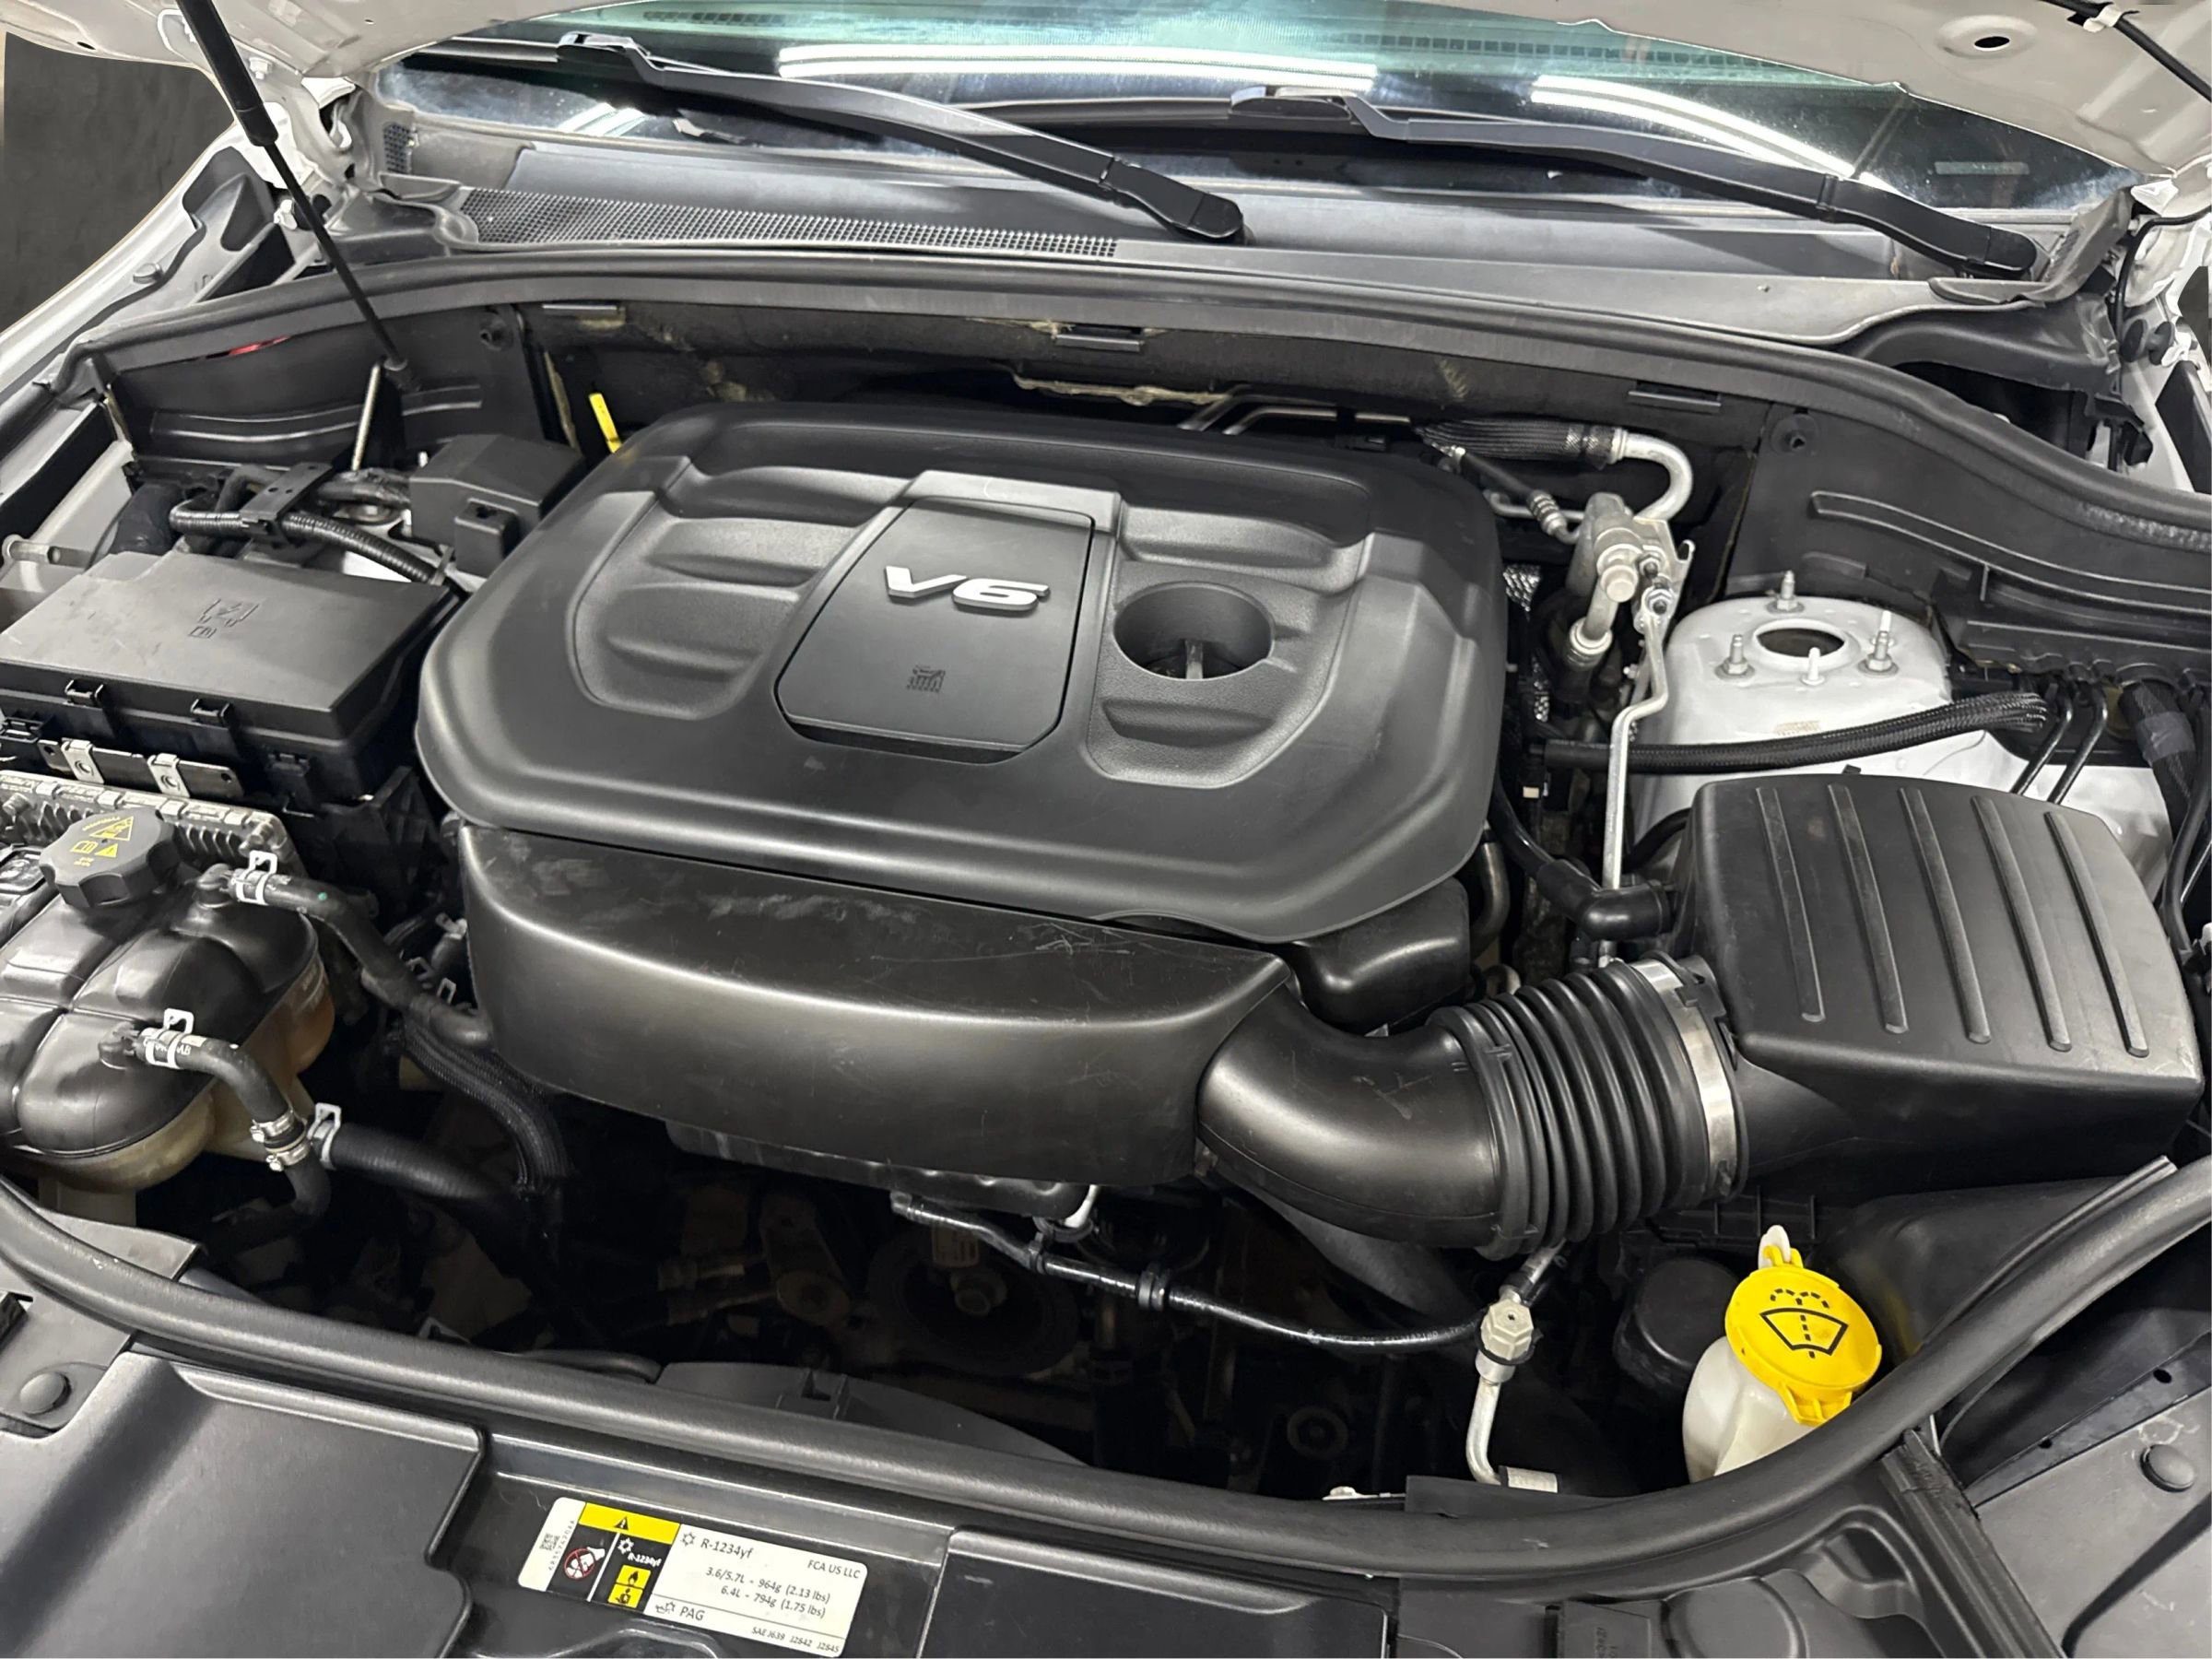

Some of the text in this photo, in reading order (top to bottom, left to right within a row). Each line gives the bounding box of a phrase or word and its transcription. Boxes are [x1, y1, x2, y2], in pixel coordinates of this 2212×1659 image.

[885, 564, 1052, 612] V6
[700, 1537, 754, 1559] R-1234yf
[807, 1559, 861, 1579] FCA US LLC
[706, 1567, 745, 1583] 3.6/5.7L
[758, 1578, 782, 1594] 964g
[785, 1584, 811, 1598] (2.13
[812, 1590, 831, 1605] lbs)
[721, 1585, 740, 1598] 6.4L
[753, 1593, 778, 1608] 794g
[780, 1598, 806, 1613] (1.75
[807, 1605, 826, 1619] lbs)
[679, 1606, 706, 1621] PAG
[752, 1626, 767, 1637] SAE
